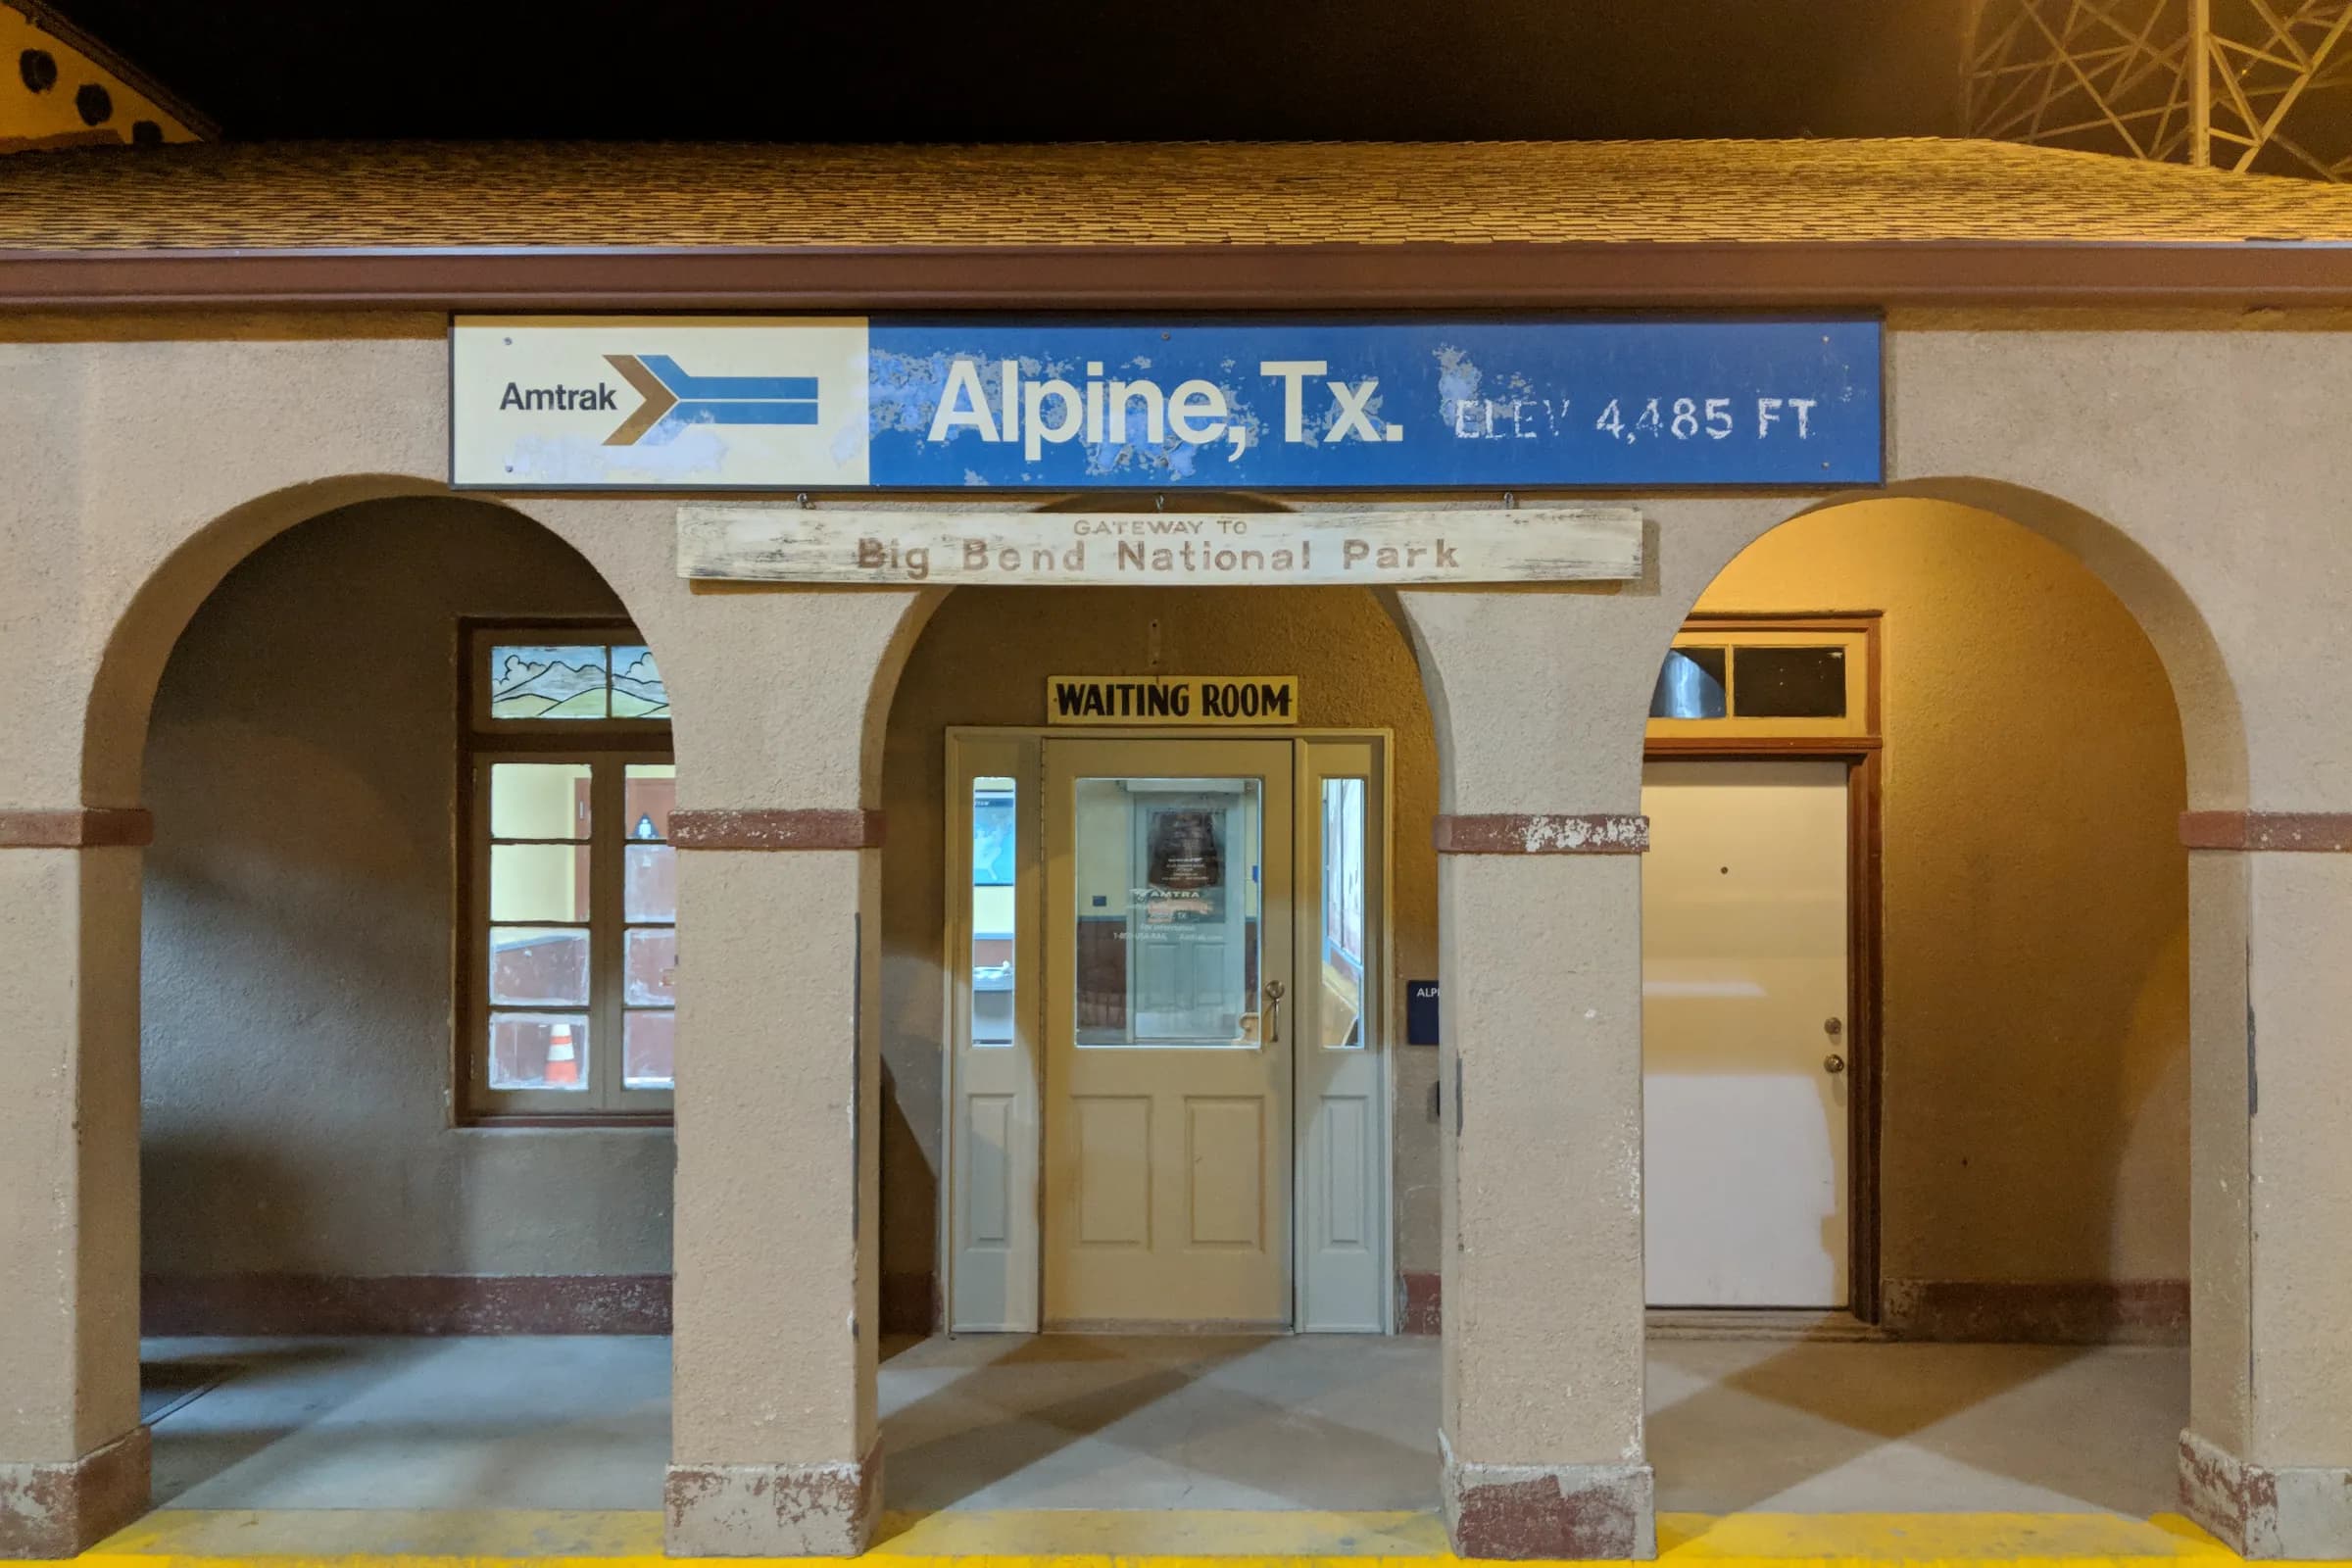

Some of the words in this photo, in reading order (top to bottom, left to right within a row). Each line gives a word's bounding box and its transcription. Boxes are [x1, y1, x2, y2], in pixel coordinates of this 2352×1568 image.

[499, 381, 618, 411] Amtrak
[926, 359, 1247, 463] Alpine,
[1259, 360, 1404, 443] Tx.
[1454, 397, 1570, 440] ELEV
[1595, 397, 1734, 446] 4,485
[1757, 397, 1818, 440] FT
[1073, 518, 1203, 536] GATEWAY
[1216, 519, 1248, 536] TO
[858, 537, 930, 581] Big
[962, 538, 1086, 571] Bend
[1117, 539, 1311, 572] National
[1343, 538, 1460, 570] Park
[1055, 683, 1190, 717] WAITING
[1201, 683, 1290, 718] ROOM
